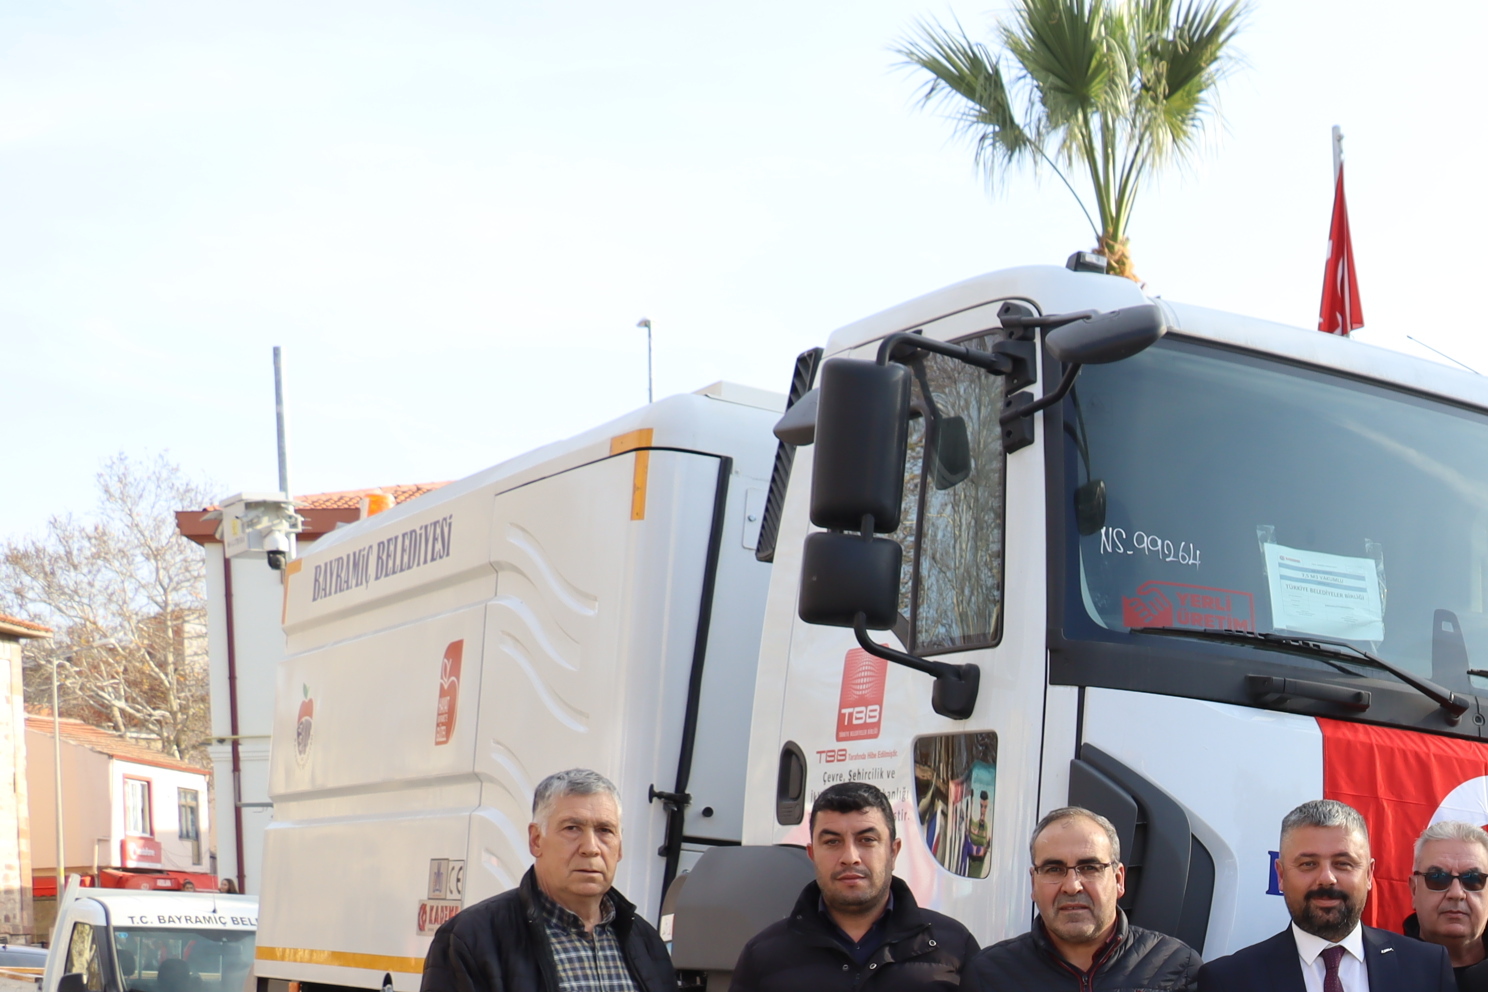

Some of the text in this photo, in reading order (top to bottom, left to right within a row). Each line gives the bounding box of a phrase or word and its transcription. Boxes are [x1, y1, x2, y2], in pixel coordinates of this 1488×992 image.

[312, 514, 453, 602] BAYRAMİÇ BELEDİYESİ
[1176, 592, 1231, 612] YERLİ
[1176, 608, 1248, 631] ÜRETİM
[841, 705, 880, 726] TBB
[816, 748, 847, 764] TBB
[886, 769, 896, 779] ve
[128, 915, 153, 925] T.C.
[157, 914, 227, 927] BAYRAMİÇ
